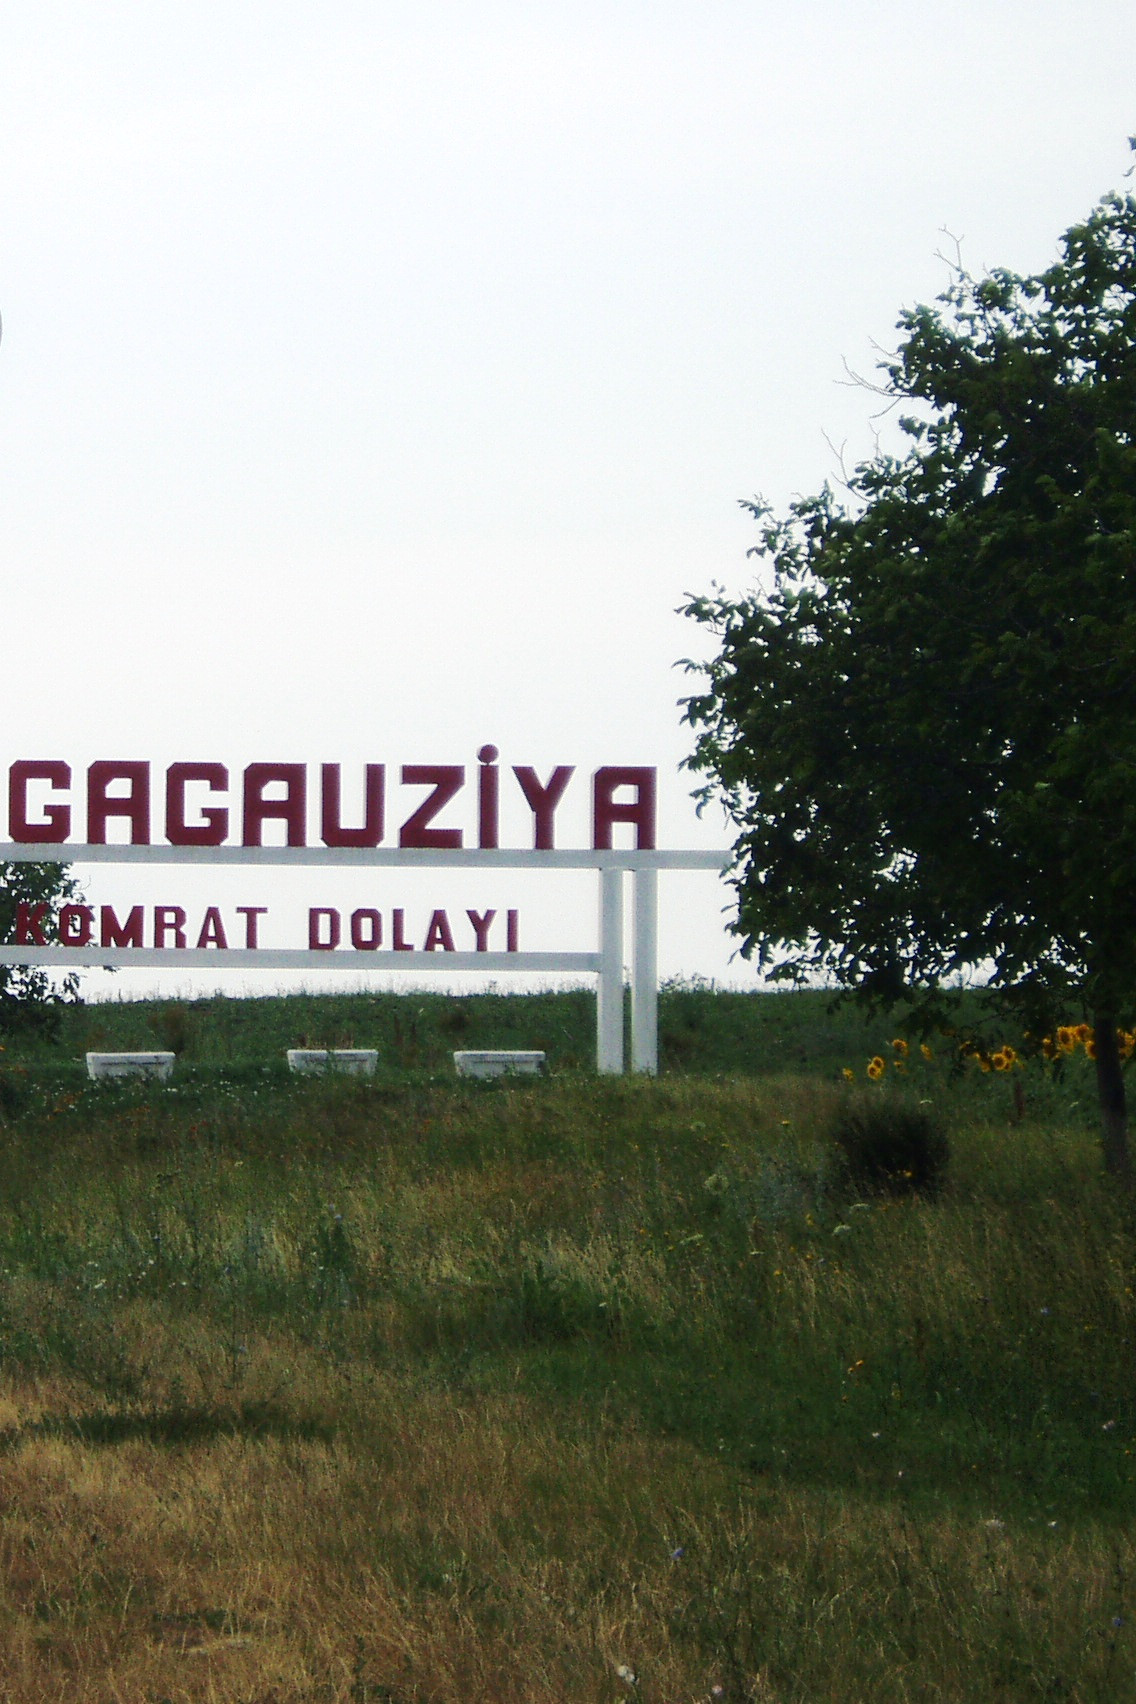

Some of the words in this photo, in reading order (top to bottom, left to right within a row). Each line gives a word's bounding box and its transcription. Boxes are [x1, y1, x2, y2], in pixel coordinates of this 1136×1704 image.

[8, 743, 658, 850] GAGAUZİYA
[15, 902, 269, 949] KOMRAT
[308, 907, 519, 952] DOLAYI
